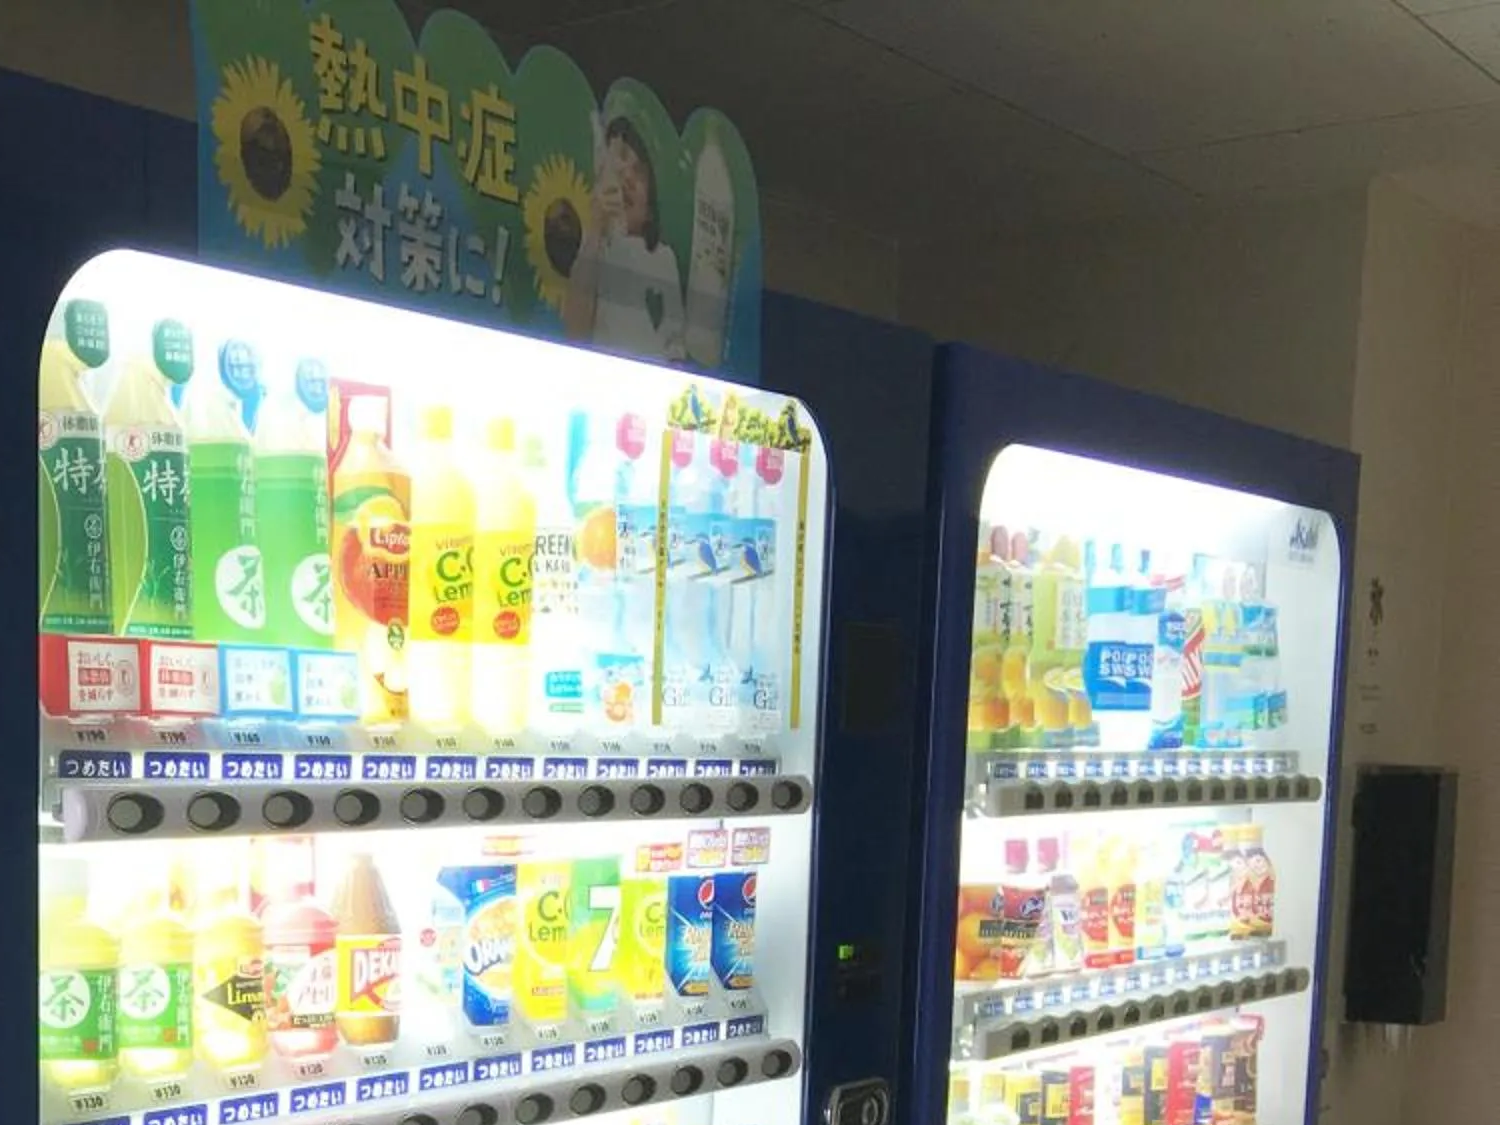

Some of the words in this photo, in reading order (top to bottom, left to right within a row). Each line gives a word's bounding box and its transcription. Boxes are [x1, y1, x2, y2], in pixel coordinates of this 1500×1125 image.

[308, 13, 523, 204] 熱中症
[332, 172, 511, 305] 対策に!
[534, 535, 573, 557] REEN
[225, 553, 262, 620] 茶
[65, 759, 125, 777] つめたい
[149, 760, 206, 777] つめたい
[226, 760, 279, 777] つめたい
[299, 761, 348, 777] つめたい
[366, 761, 414, 778] つめたい
[430, 762, 473, 779] つめたい
[41, 974, 86, 1022] 茶
[422, 1069, 467, 1089] つめたい
[294, 1089, 343, 1110] つめたい
[360, 1079, 407, 1101] つめたい
[223, 1101, 275, 1122] つめたい
